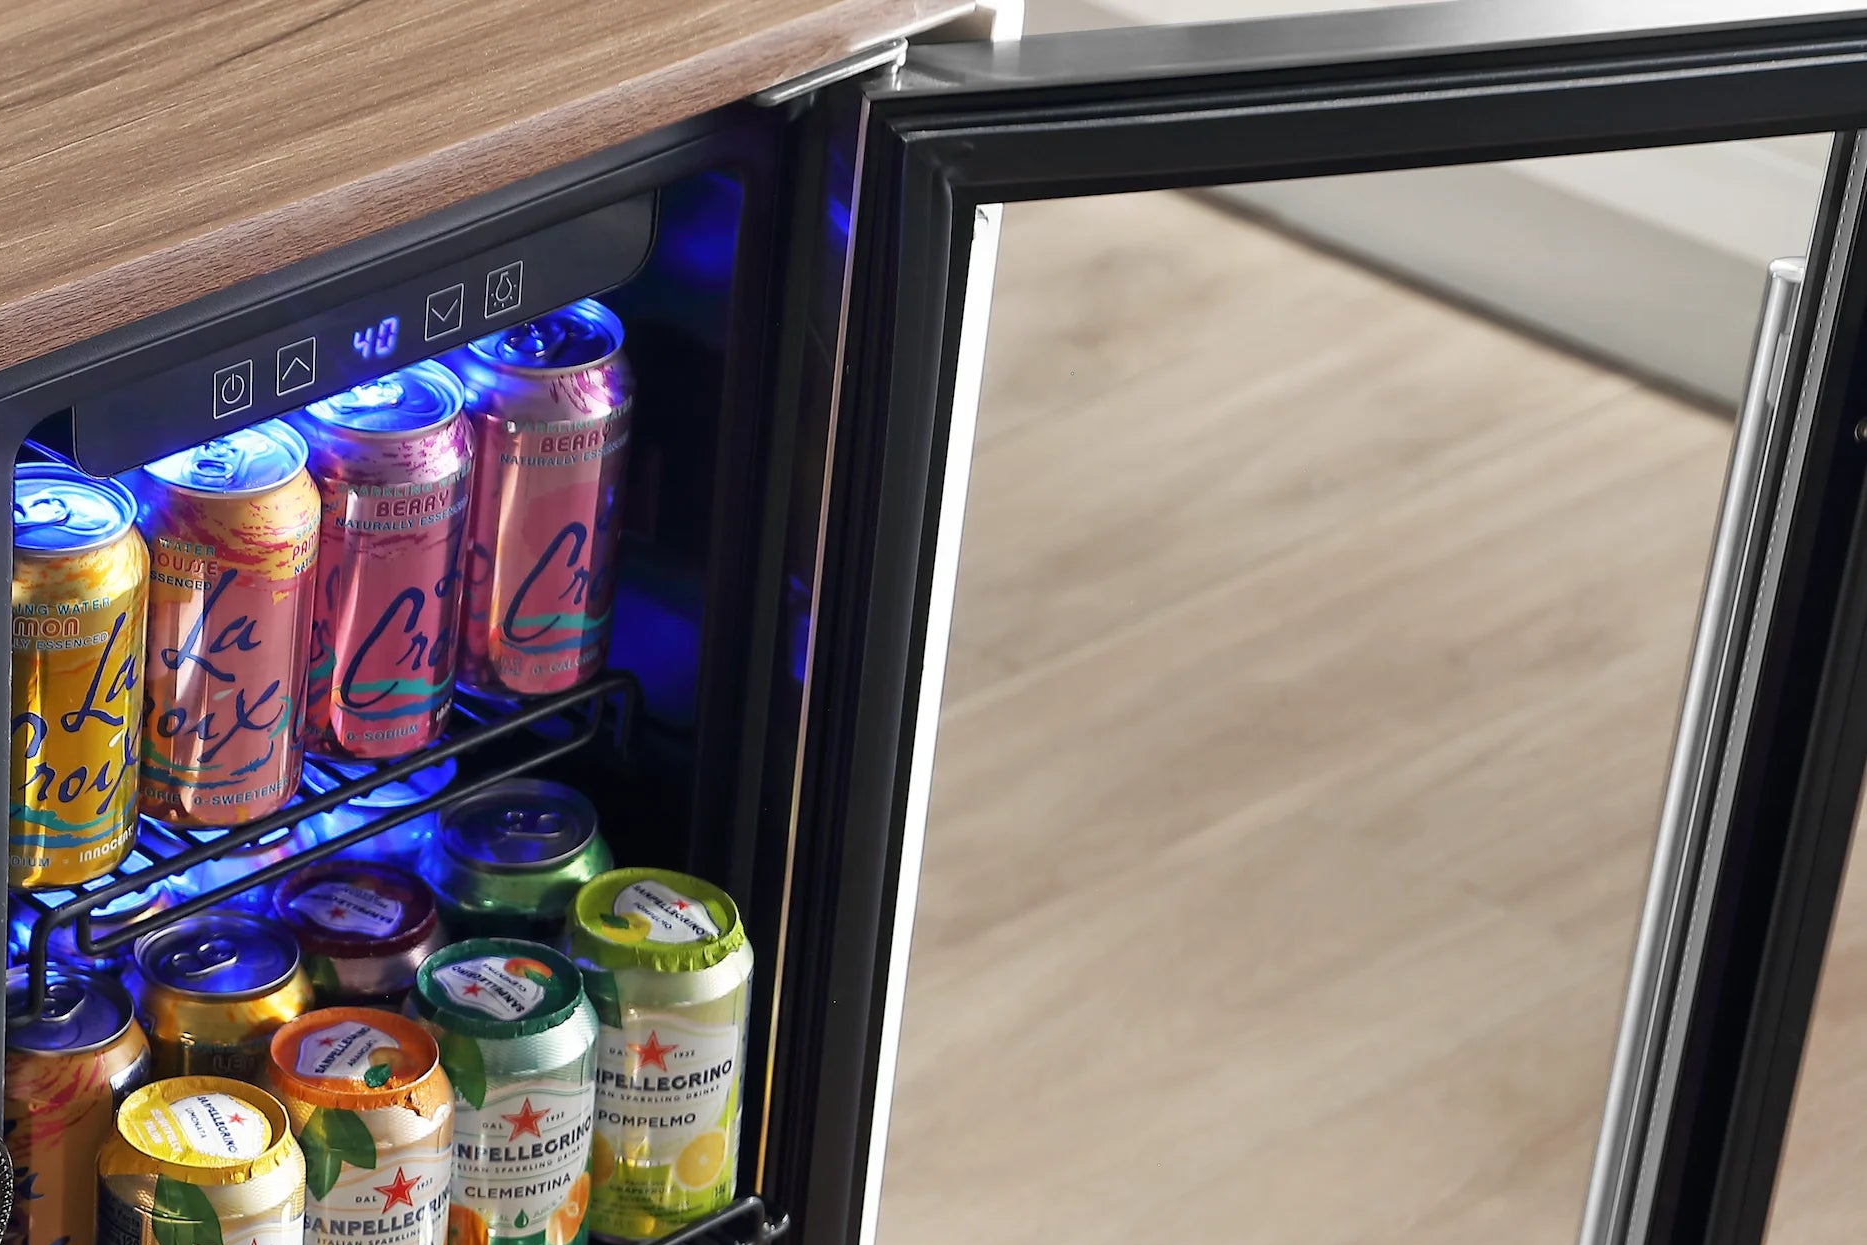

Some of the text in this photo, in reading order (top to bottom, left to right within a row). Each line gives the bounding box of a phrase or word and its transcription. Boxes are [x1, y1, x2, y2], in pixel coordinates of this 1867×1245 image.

[352, 317, 401, 358] 40
[540, 424, 612, 453] BERRY
[500, 453, 578, 467] NATURALLY
[375, 489, 449, 517] BERRY
[335, 518, 415, 531] NATURALLY
[159, 538, 216, 557] WATER
[150, 552, 219, 576] OUSSE
[150, 570, 213, 591] SSENCED
[14, 597, 111, 616] ING WATER
[161, 568, 262, 683] La
[14, 631, 110, 650] LY ESSENCED
[60, 611, 139, 734] La
[143, 680, 285, 764] roix
[12, 856, 51, 868] DIUM
[598, 1110, 697, 1129] POMPELMO
[452, 1114, 592, 1163] NPELLEGRINO
[464, 1172, 572, 1199] CLEMENTINA
